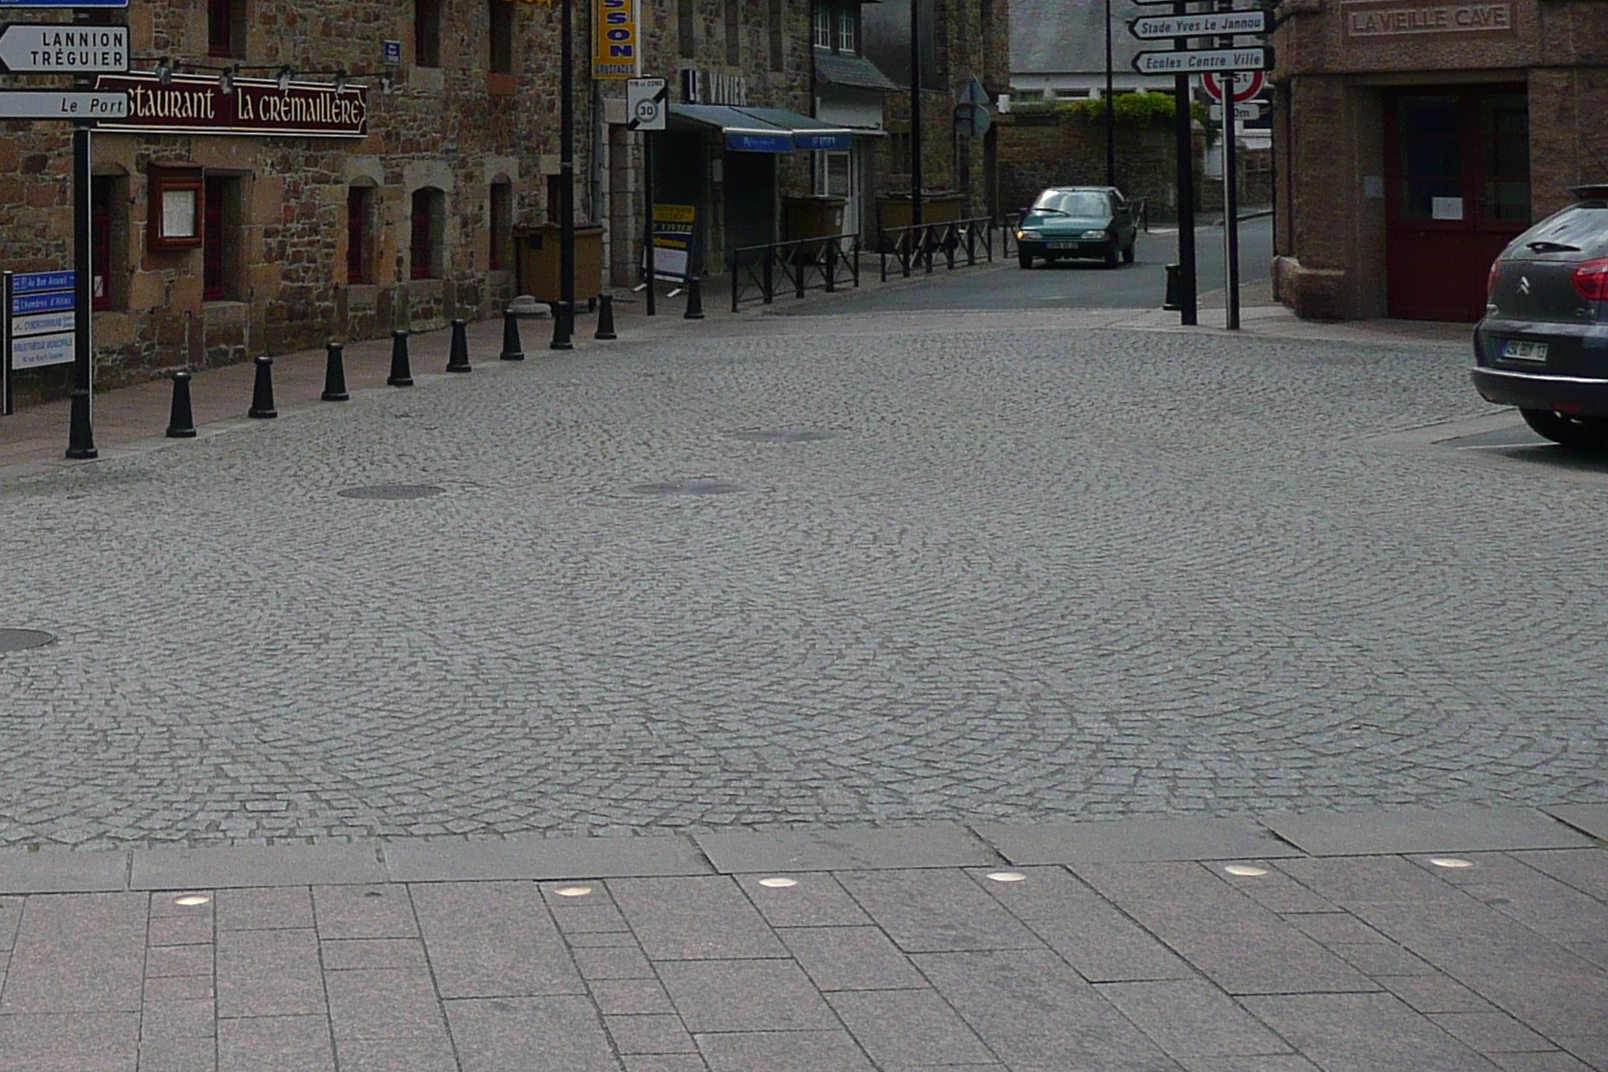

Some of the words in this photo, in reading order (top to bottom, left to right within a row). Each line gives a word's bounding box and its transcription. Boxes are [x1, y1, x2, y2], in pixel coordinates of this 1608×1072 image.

[1454, 6, 1507, 27] CAVE
[1142, 22, 1170, 34] Stade
[1176, 20, 1200, 32] Yves
[1204, 19, 1216, 30] Le
[42, 31, 123, 47] LANNION
[30, 48, 123, 66] TRÉGUIER
[1188, 56, 1226, 68] Centre
[1233, 54, 1261, 65] Ville
[709, 72, 747, 106] VIVIER
[61, 98, 78, 113] Le
[89, 98, 123, 113] Port
[640, 106, 653, 116] 30
